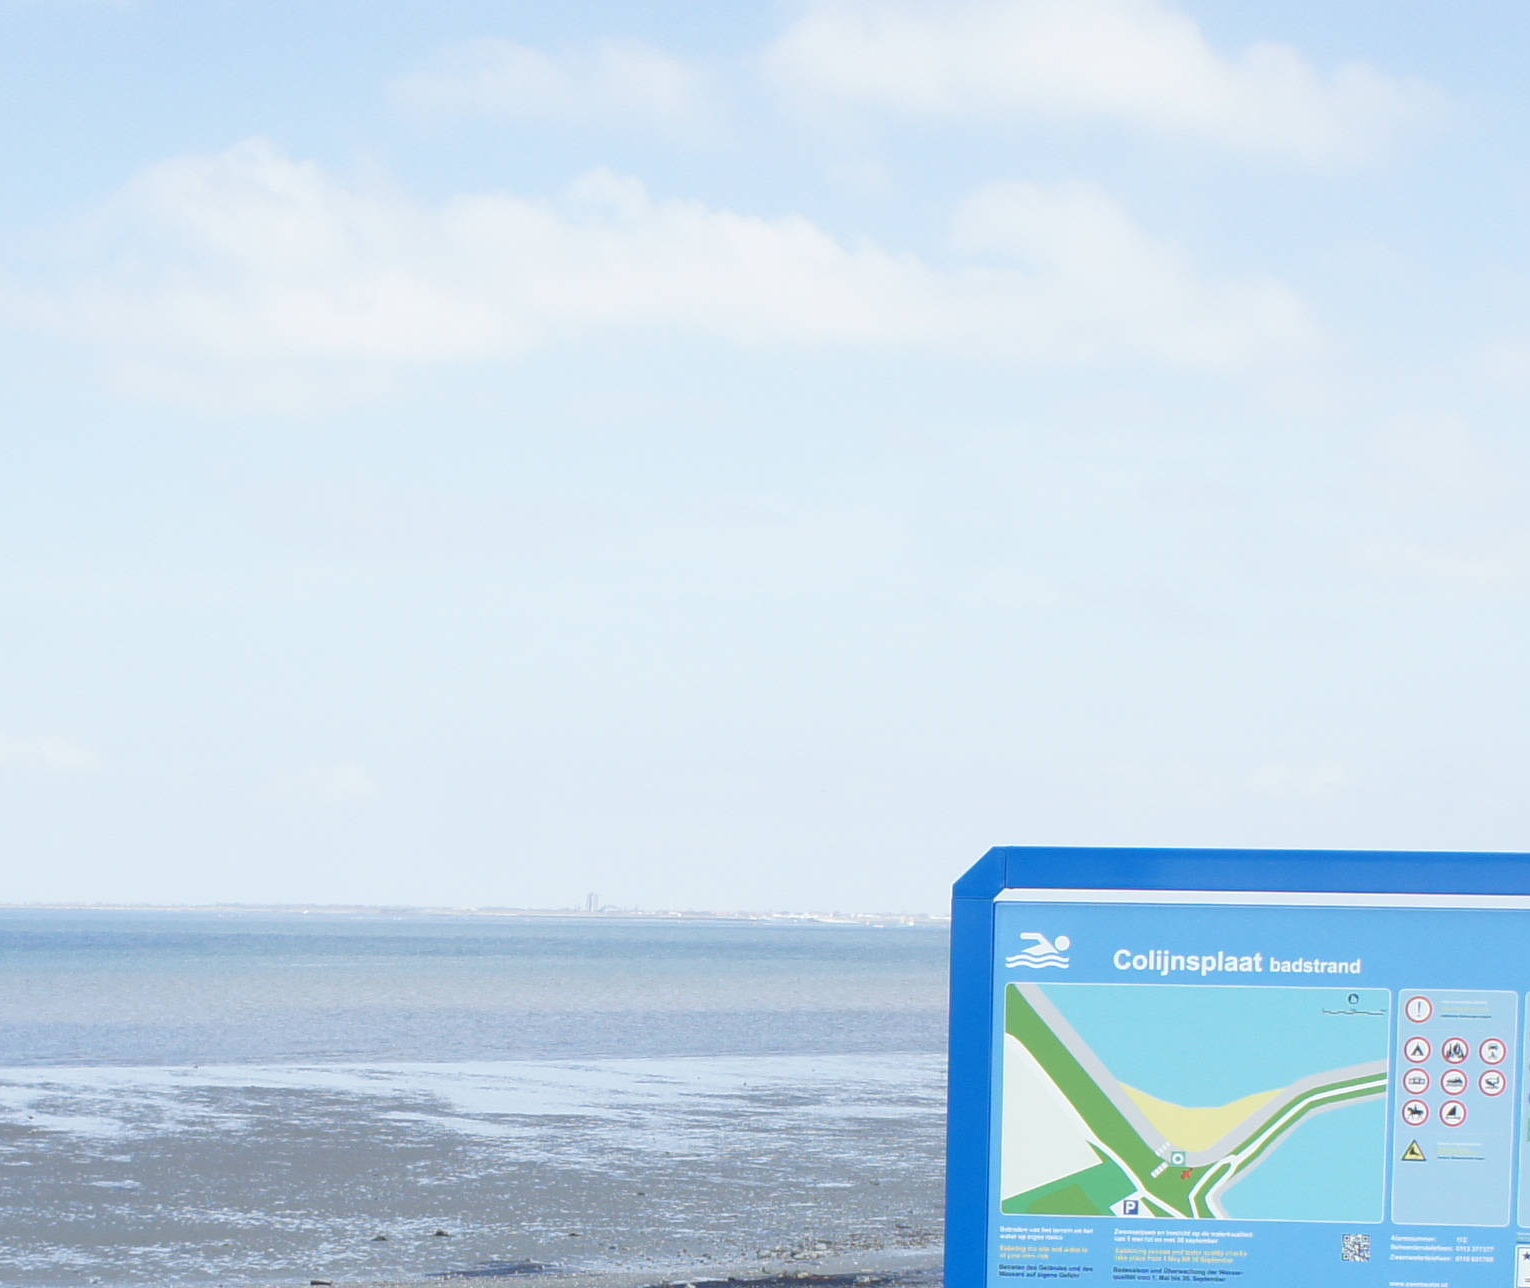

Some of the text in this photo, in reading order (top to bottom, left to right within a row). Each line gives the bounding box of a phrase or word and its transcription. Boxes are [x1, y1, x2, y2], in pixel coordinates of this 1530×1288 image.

[1113, 949, 1361, 976] Colijnsplaat badstrand
[1126, 1201, 1136, 1214] P
